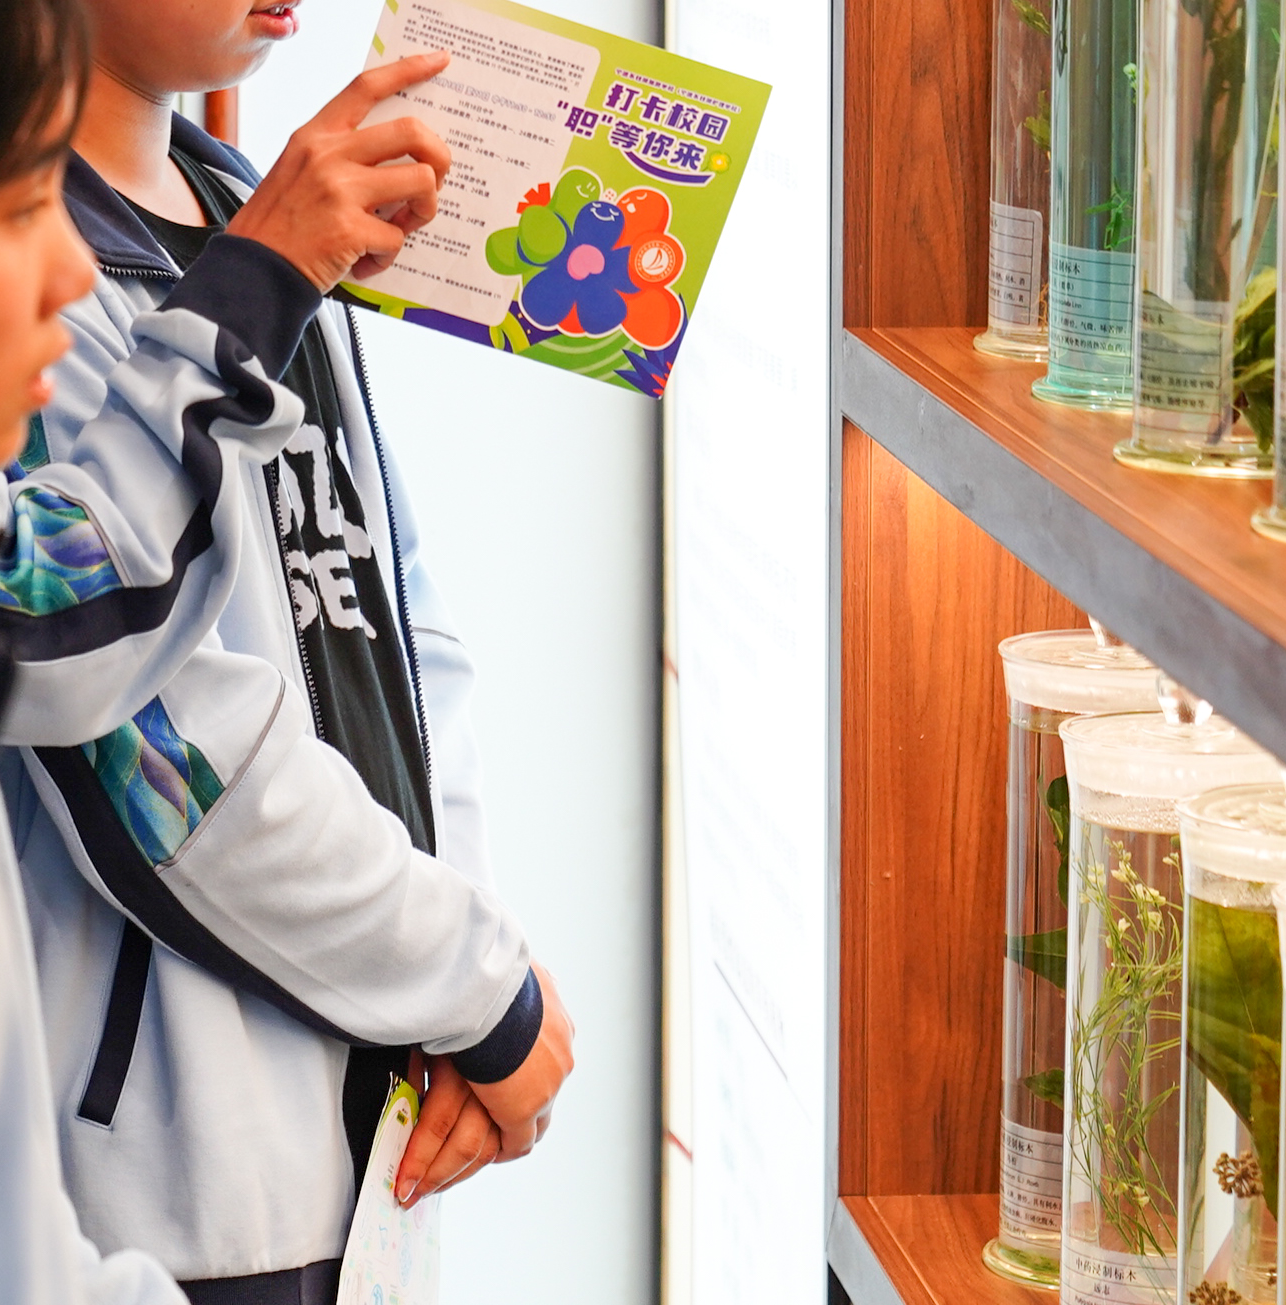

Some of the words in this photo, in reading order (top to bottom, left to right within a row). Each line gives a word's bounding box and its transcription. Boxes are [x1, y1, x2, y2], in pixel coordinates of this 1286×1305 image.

[604, 82, 729, 141] 打卡校园
[1076, 1257, 1136, 1282] 中药浸制标本
